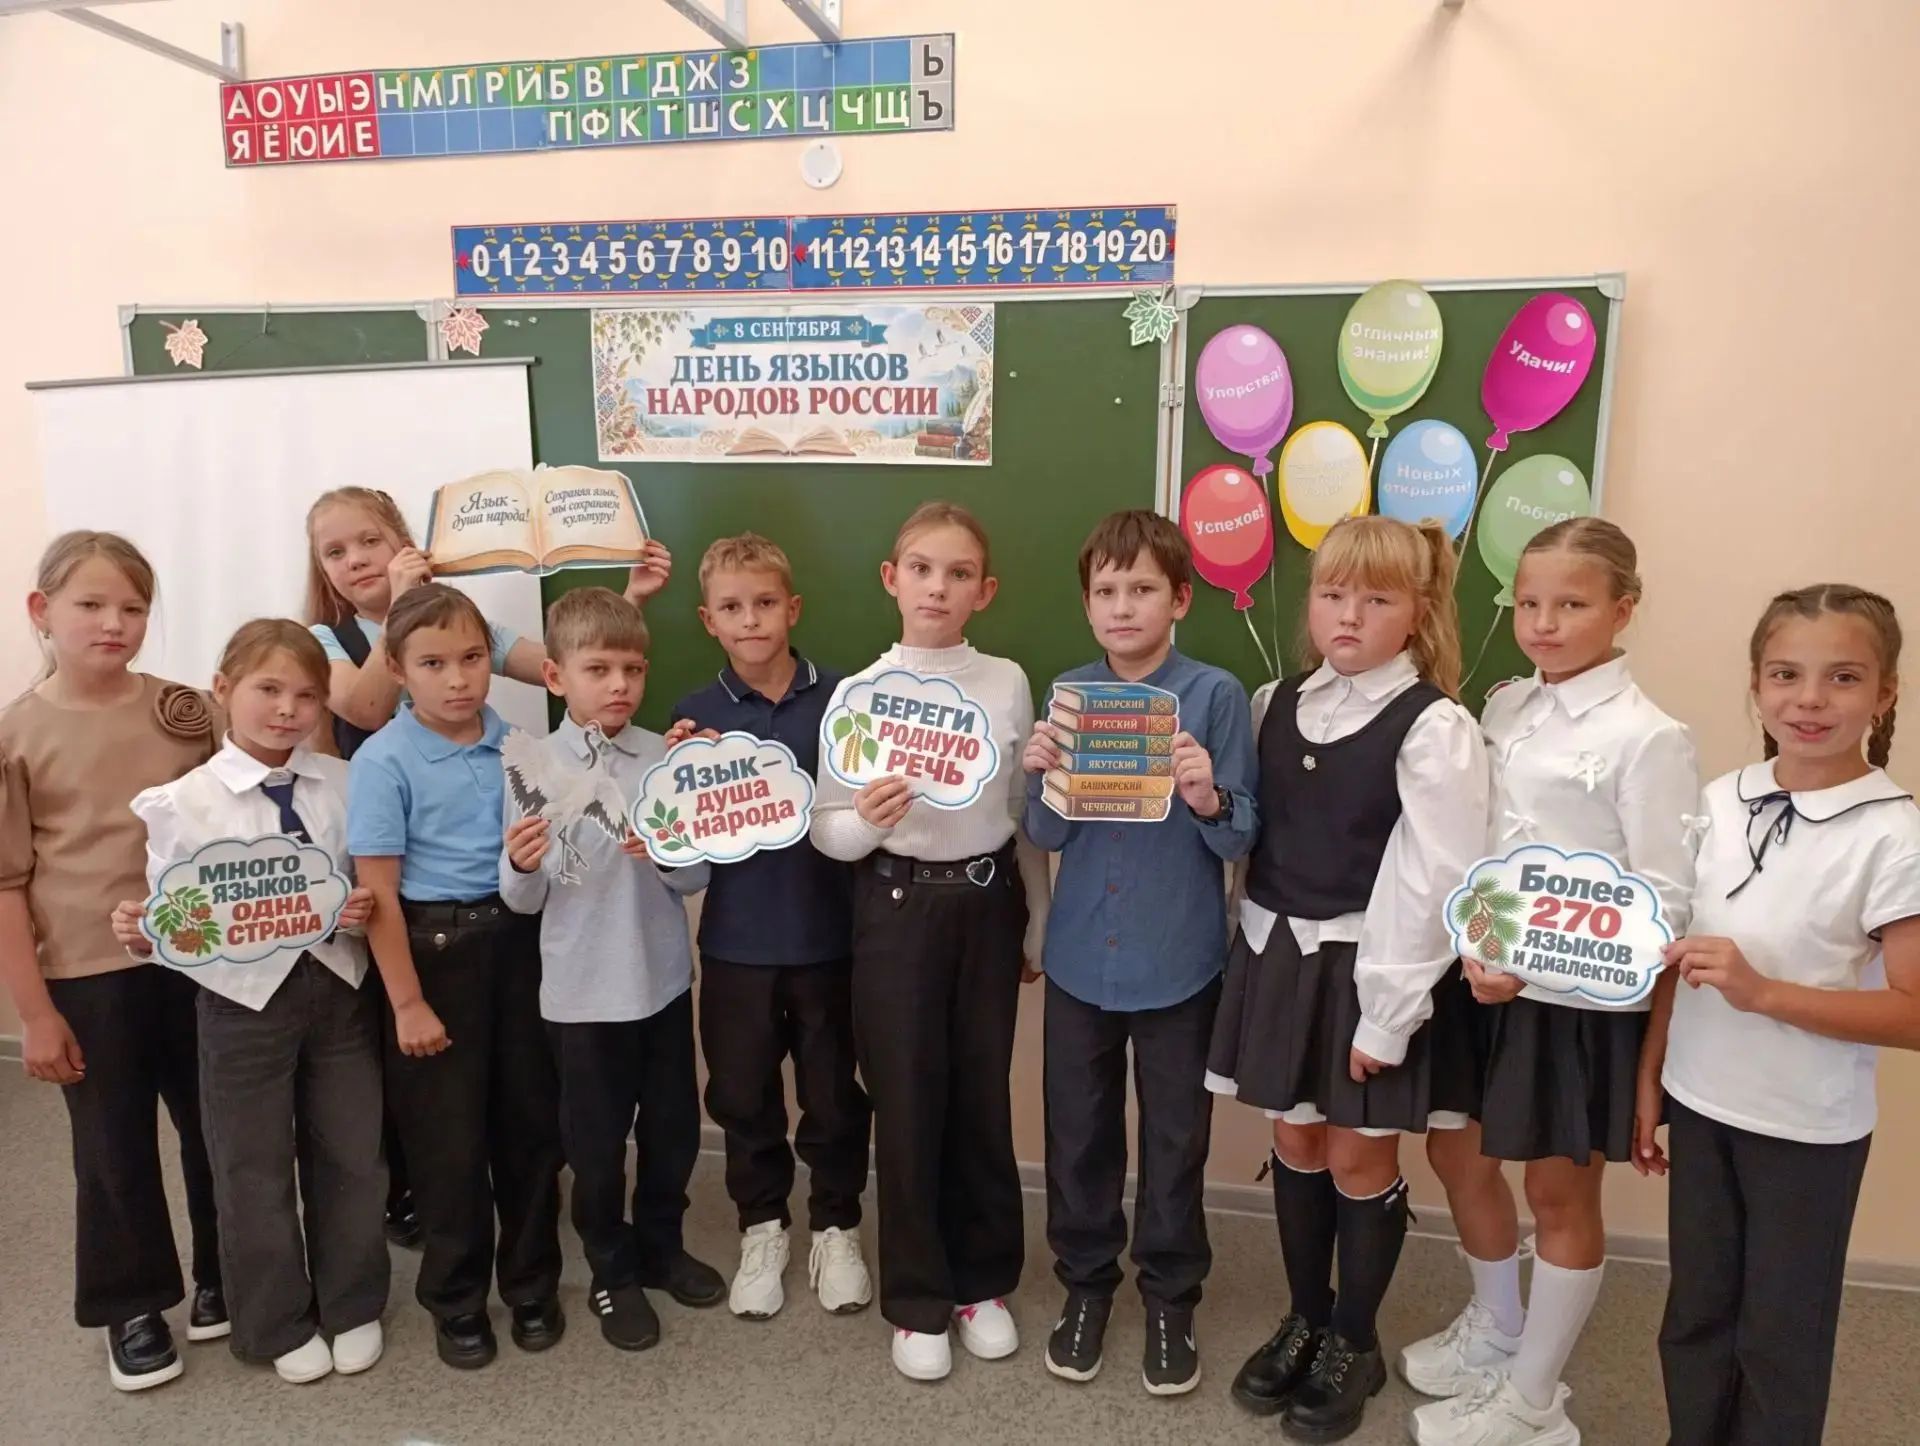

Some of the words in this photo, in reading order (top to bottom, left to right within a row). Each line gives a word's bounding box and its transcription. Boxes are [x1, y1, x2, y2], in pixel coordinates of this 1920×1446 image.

[472, 244, 490, 277] 0
[499, 244, 512, 276] 1
[524, 243, 542, 275] 2
[552, 242, 570, 275] 3
[580, 242, 599, 274] 4
[609, 241, 626, 274] 5
[637, 240, 655, 273] 6
[664, 240, 682, 272] 7
[693, 239, 711, 272] 8
[722, 238, 741, 271] 9
[752, 237, 788, 271] 10
[808, 237, 833, 269] 11
[840, 237, 870, 268] 12
[875, 236, 905, 268] 13
[911, 235, 941, 267] 14
[947, 234, 977, 266] 15
[983, 232, 1013, 264] 16
[1020, 232, 1050, 264] 17
[1056, 231, 1087, 263] 18
[1093, 230, 1124, 262] 19
[1130, 229, 1166, 262] 20
[734, 323, 745, 338] 8
[750, 320, 842, 339] СЕНТЯБРЯ
[1351, 322, 1438, 342] Отличных
[670, 355, 761, 386] ДЕНЬ
[767, 353, 909, 383] ЯЗЫКОВ
[1509, 340, 1576, 373] Удачи!
[1206, 365, 1284, 400] Упорства!
[646, 387, 799, 419] НАРОДОВ
[809, 386, 939, 416] РОССИИ
[1397, 463, 1463, 481] Новых
[460, 491, 508, 514] Язык
[545, 488, 591, 504] Сохраняя
[592, 488, 619, 500] язык,
[1384, 480, 1471, 497] открытий!
[452, 512, 483, 531] душа
[486, 509, 530, 526] народа!
[549, 504, 567, 516] мы
[568, 501, 620, 516] сохраняем
[562, 511, 616, 528] культуру!
[1194, 503, 1265, 535] Успехов!
[870, 692, 976, 734] БЕРЕГИ
[1092, 698, 1145, 709] ТАТАРСКИЙ
[1092, 718, 1138, 730] РУССКИЙ
[878, 721, 980, 761] РОДНУЮ
[1088, 739, 1139, 749] АВАРСКИЙ
[885, 750, 965, 786] РЕЧЬ
[1088, 759, 1138, 770] ЯКУТСКИЙ
[696, 779, 771, 816] душа
[1080, 780, 1142, 791] БАШКИРСКИЙ
[692, 798, 796, 840] народа
[1081, 801, 1136, 812] ЧЕЧЕНСКИЙ
[199, 854, 300, 885] МНОГО
[1518, 863, 1634, 908] Более
[232, 894, 313, 921] ОДНА
[1527, 895, 1622, 940] 270
[226, 913, 322, 946] СТРАНА
[1522, 928, 1633, 966] языков
[1512, 949, 1525, 966] и
[1527, 953, 1639, 988] диалектов
